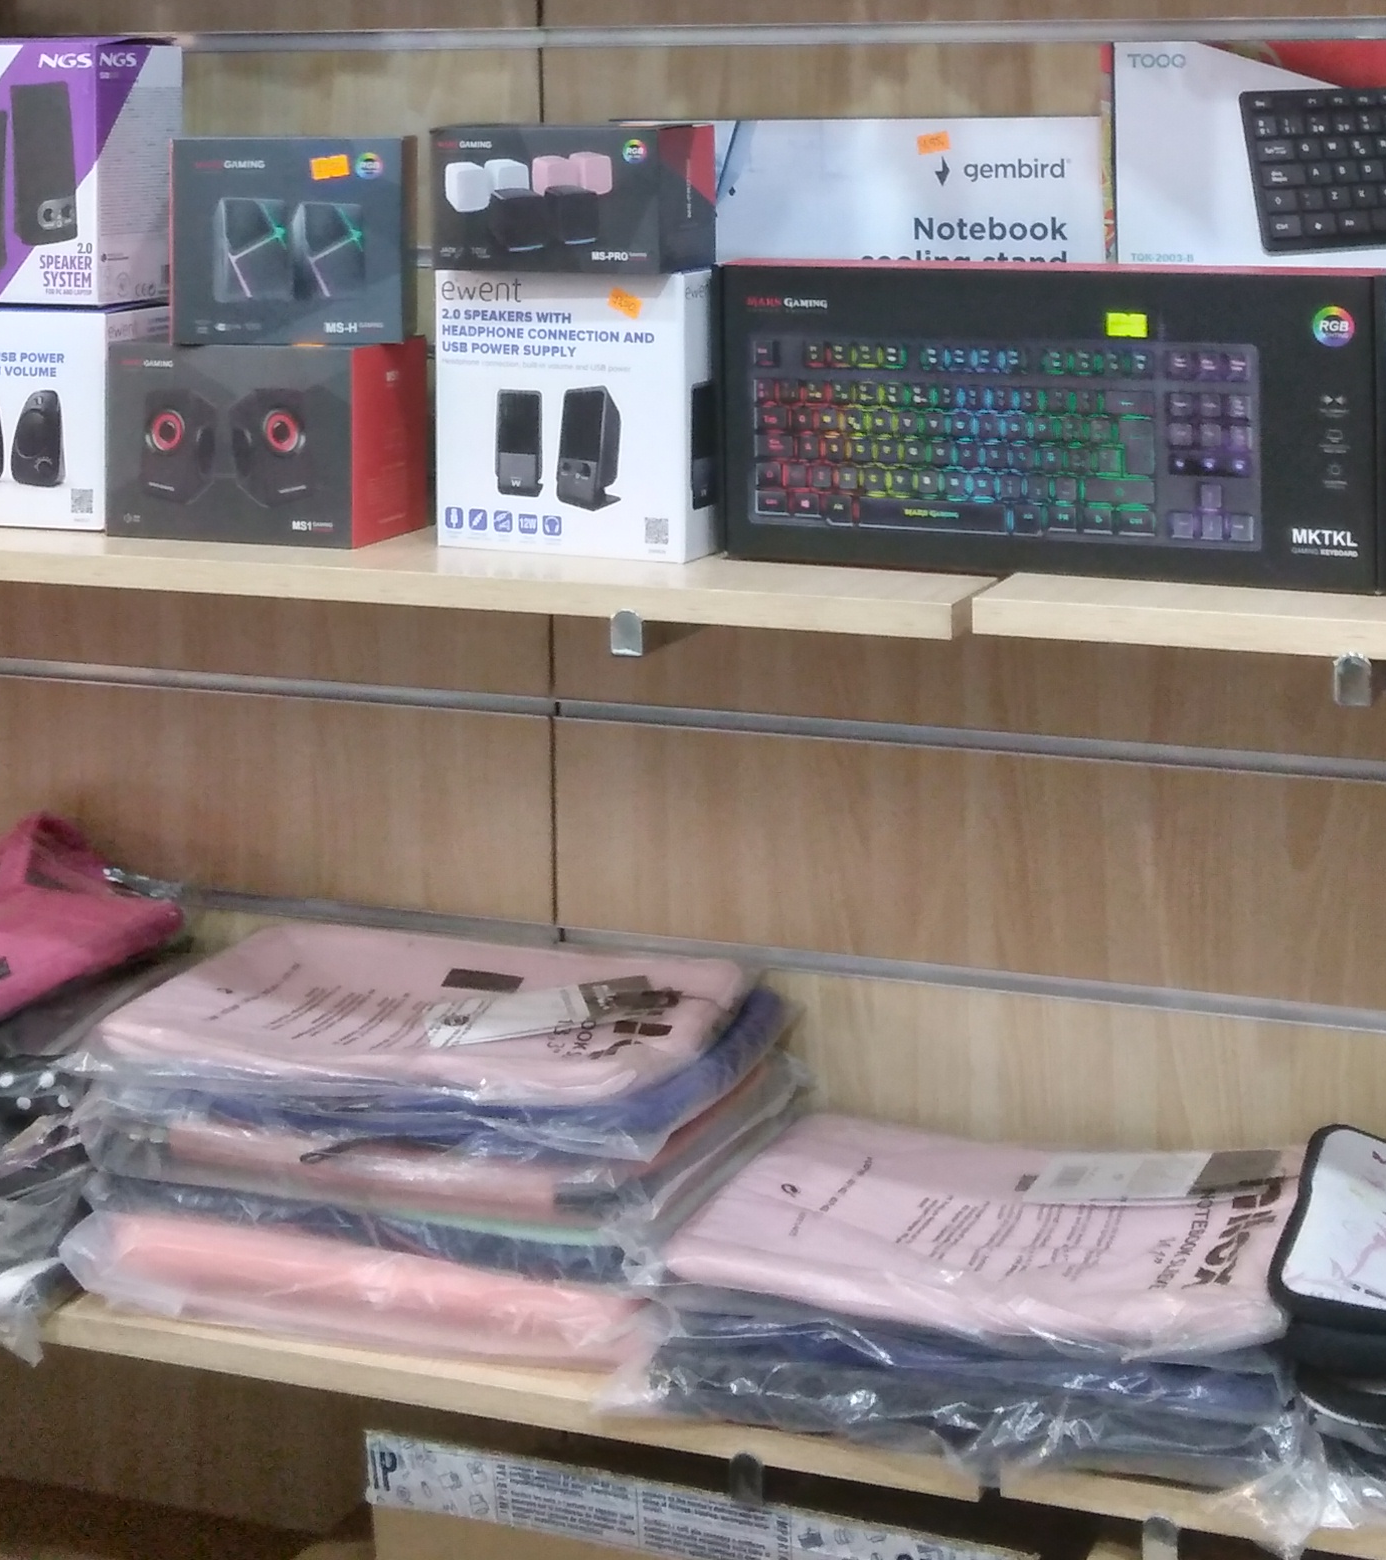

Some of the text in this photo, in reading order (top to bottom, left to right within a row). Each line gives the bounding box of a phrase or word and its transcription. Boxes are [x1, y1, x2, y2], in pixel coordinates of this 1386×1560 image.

[37, 51, 94, 70] NGS
[99, 51, 138, 68] NGS
[1126, 52, 1187, 70] TOOQ
[459, 139, 493, 150] GAMING
[625, 145, 644, 157] RGB
[223, 159, 266, 170] GAMING
[963, 158, 1066, 182] gembird
[913, 216, 1069, 242] Notebook
[76, 242, 94, 255] 2.0
[590, 250, 629, 262] MS-PRO
[39, 254, 93, 271] SPEAKER
[42, 270, 93, 289] SYSTEM
[441, 277, 522, 303] ewent
[442, 308, 572, 324] 2.0 SPEAKERS WITH
[324, 321, 358, 334] MS-H
[441, 324, 656, 345] HEADPHONE CONNECTION AND
[1318, 320, 1350, 334] RGB
[441, 340, 577, 358] USB POWER SUPPLY
[20, 352, 66, 364] POWER
[143, 359, 174, 369] GAMING
[5, 365, 58, 378] VOLUME
[292, 520, 311, 532] MS1
[1291, 527, 1359, 547] MKTKL
[1319, 548, 1359, 558] KEYBOARD
